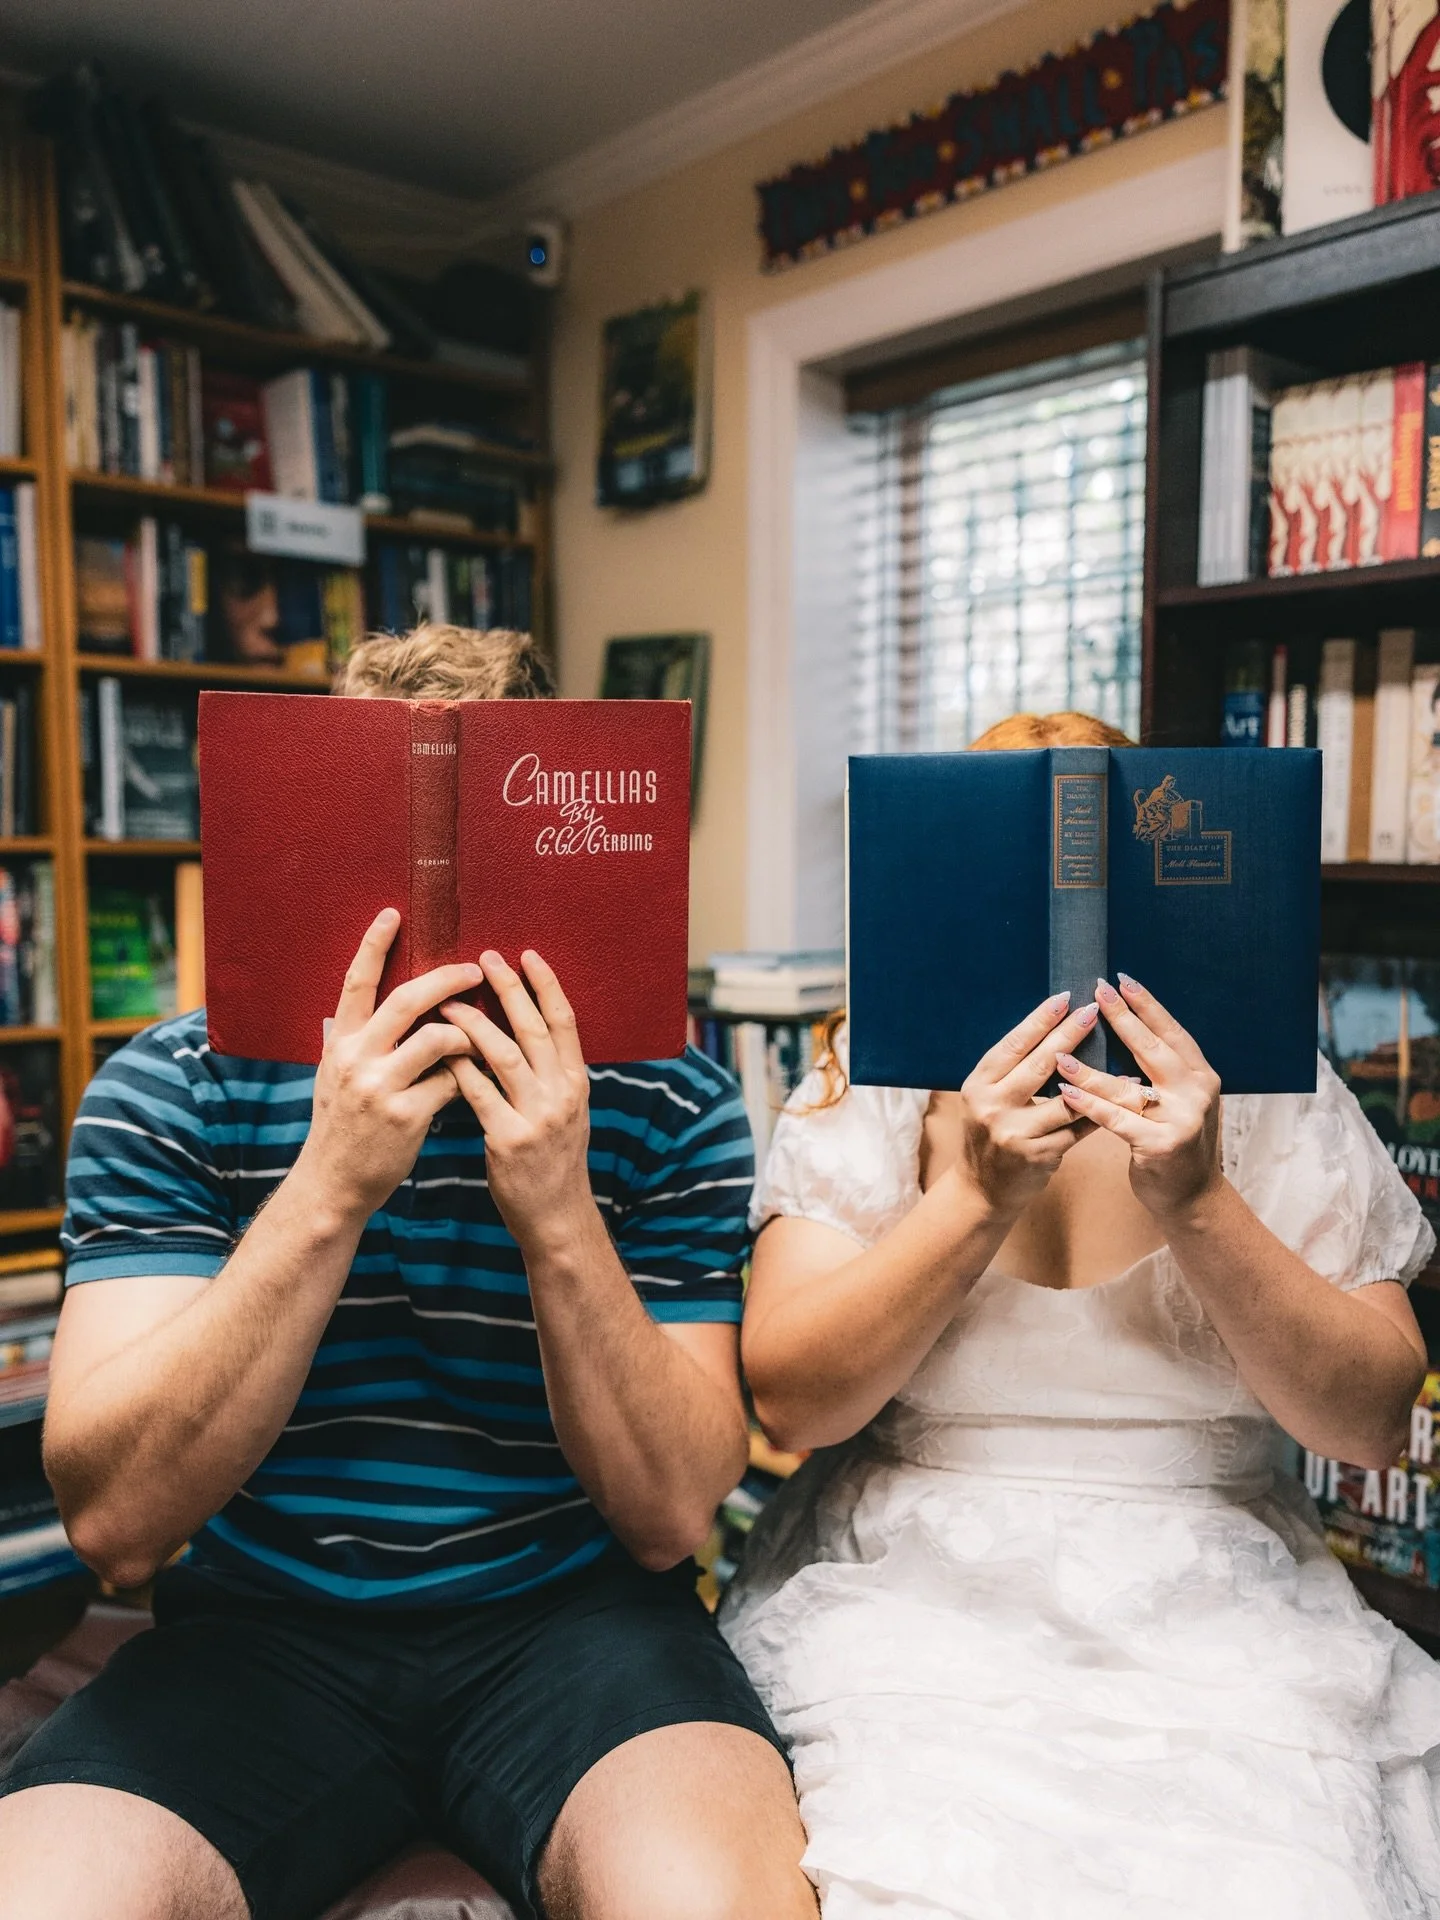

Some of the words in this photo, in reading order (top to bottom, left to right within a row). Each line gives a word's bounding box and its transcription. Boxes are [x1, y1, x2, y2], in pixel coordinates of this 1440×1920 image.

[412, 742, 457, 756] CAMELLIAS
[502, 753, 657, 807] CAMELLIAS
[560, 798, 604, 854] By
[587, 825, 653, 855] GERBING
[1164, 858, 1186, 868] Moll
[1186, 858, 1221, 868] Flanders
[1361, 1467, 1432, 1530] ART
